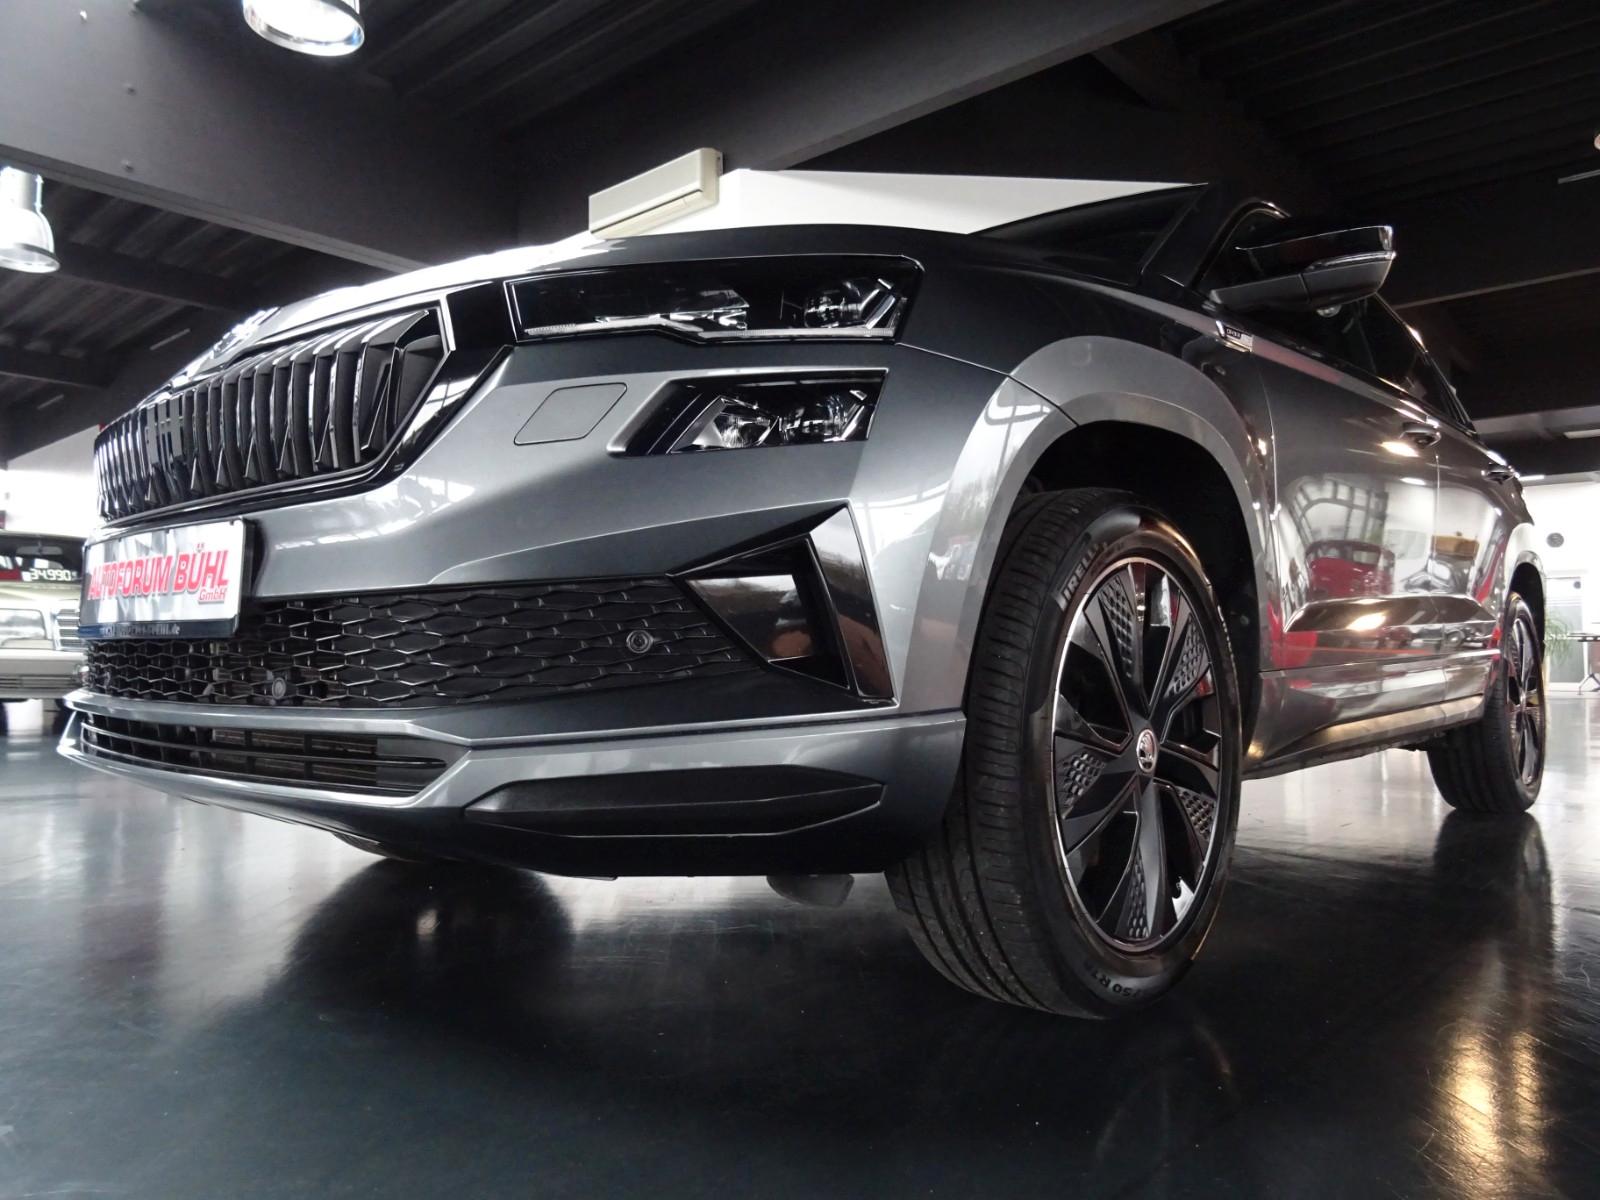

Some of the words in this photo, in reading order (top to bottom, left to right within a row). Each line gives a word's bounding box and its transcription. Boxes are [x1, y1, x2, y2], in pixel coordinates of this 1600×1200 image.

[88, 554, 173, 600] AUTOFORUM
[173, 543, 230, 593] BÜHL
[199, 587, 228, 601] GmbH
